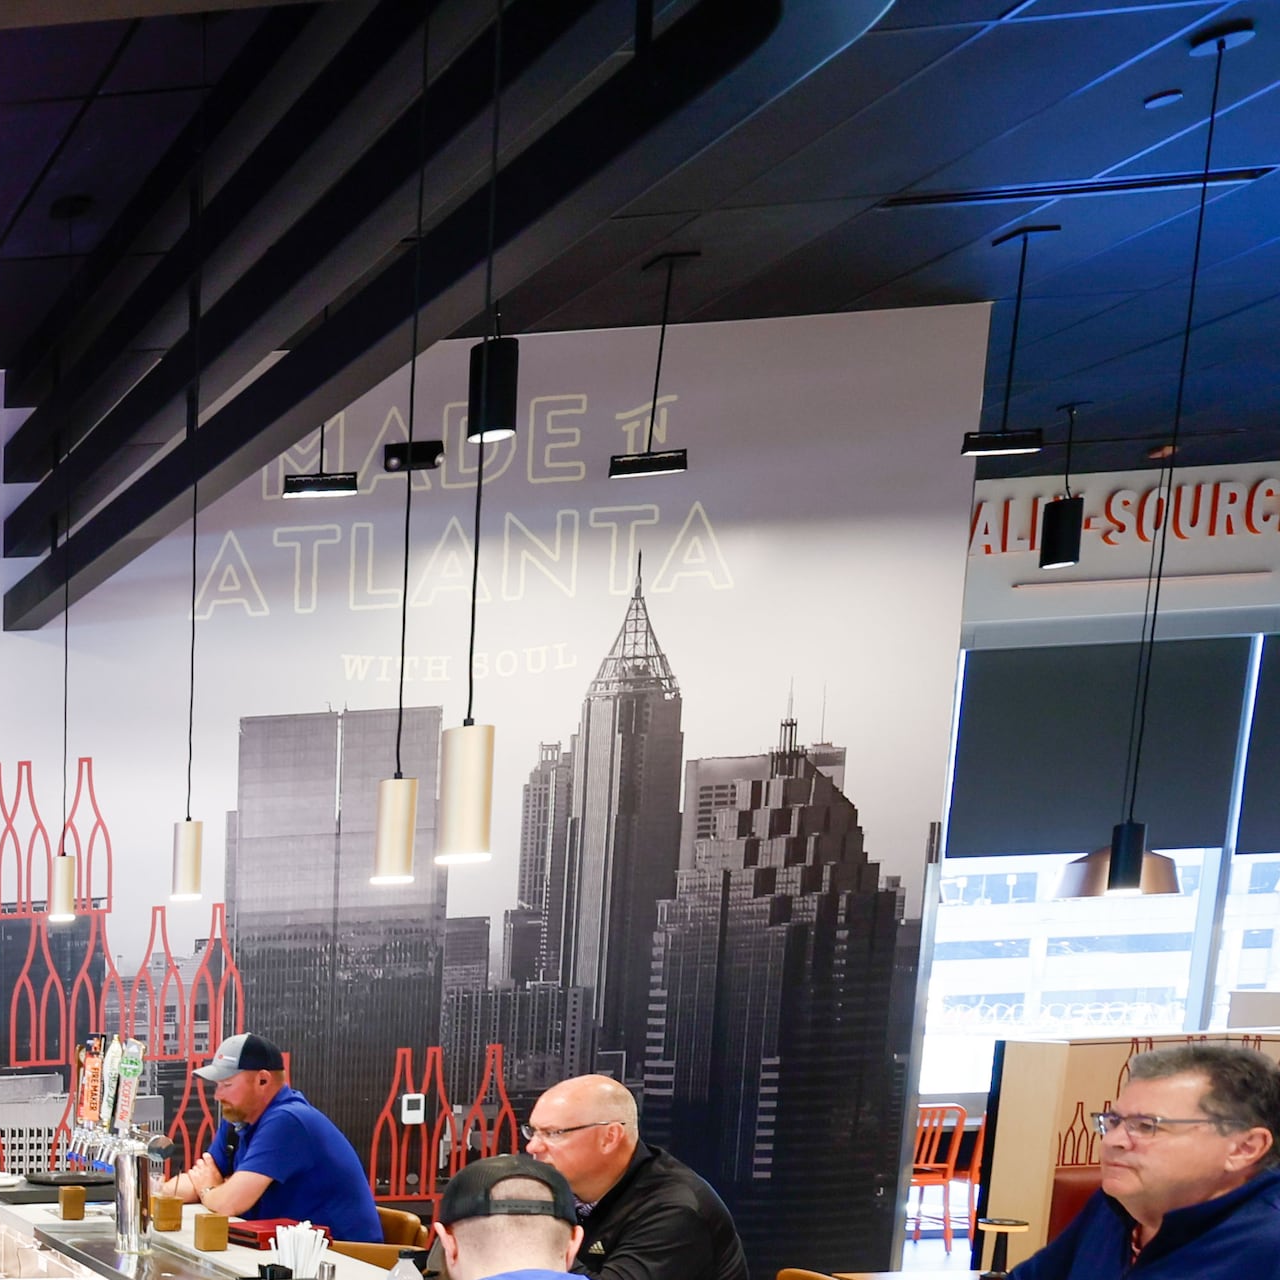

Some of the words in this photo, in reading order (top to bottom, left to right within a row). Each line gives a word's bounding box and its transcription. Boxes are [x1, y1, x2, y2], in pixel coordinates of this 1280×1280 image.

[260, 393, 588, 500] MADE
[189, 500, 735, 620] ATLANTA
[341, 652, 452, 683] WITH
[472, 641, 578, 680] SOUL
[90, 1066, 100, 1084] FIRE
[89, 1084, 99, 1112] MAKER
